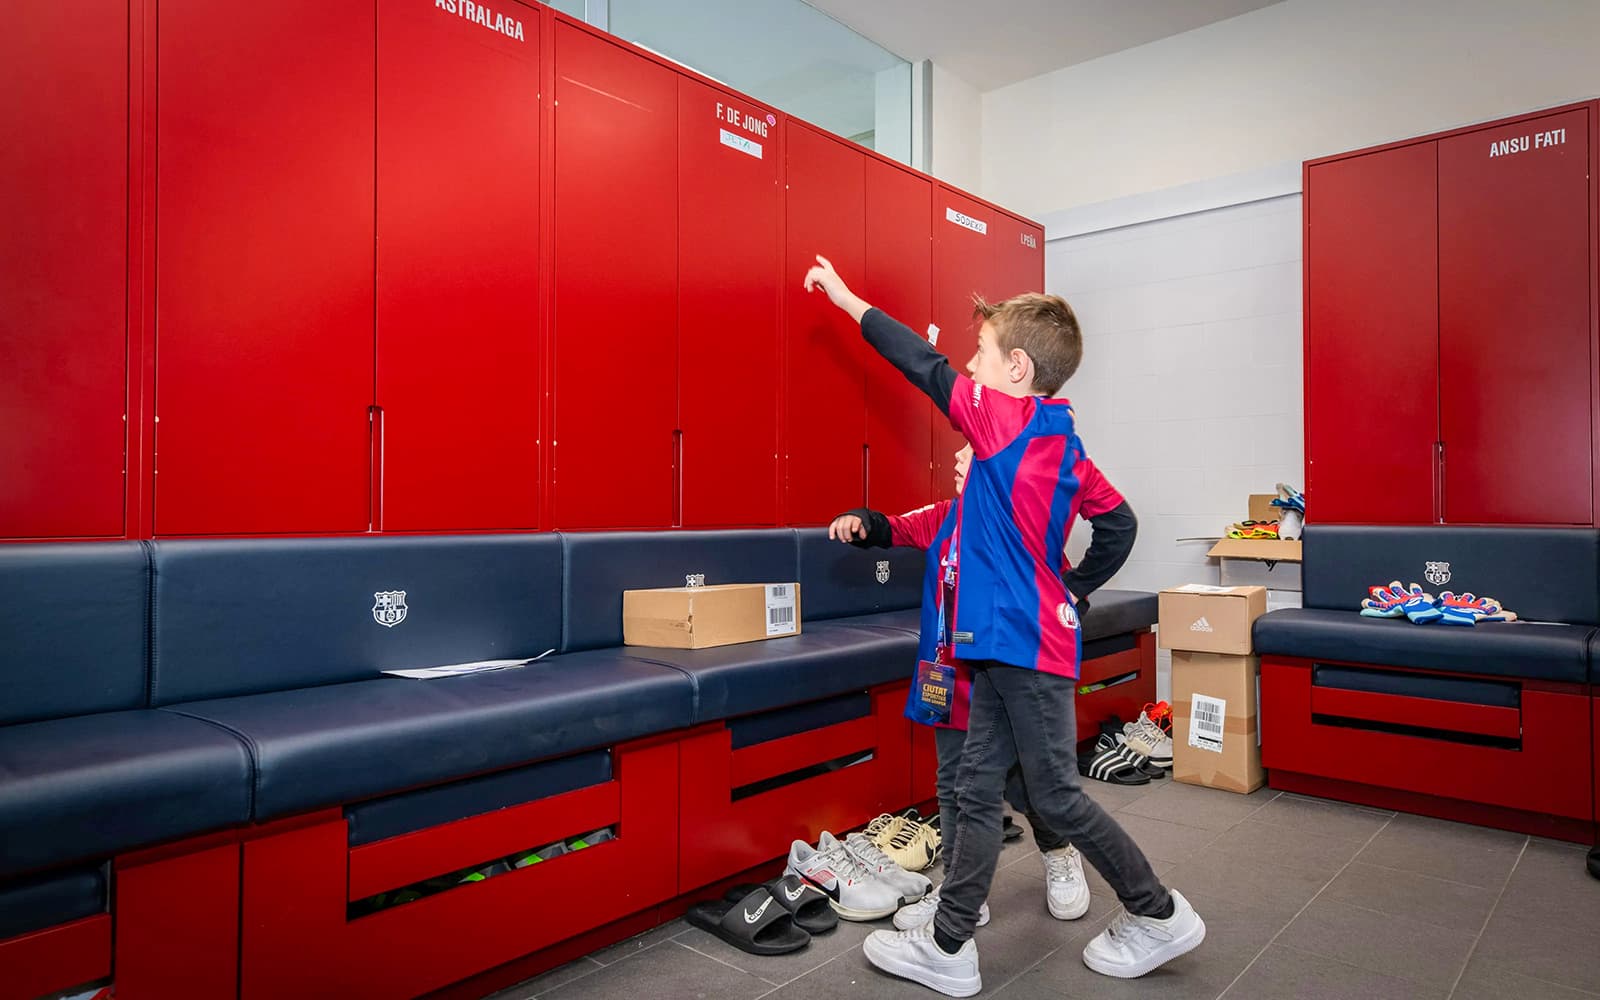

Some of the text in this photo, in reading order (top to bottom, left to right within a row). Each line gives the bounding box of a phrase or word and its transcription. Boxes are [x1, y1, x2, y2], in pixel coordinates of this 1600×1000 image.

[716, 102, 768, 138] F. DE JONG
[1489, 128, 1566, 158] ANSU FATI
